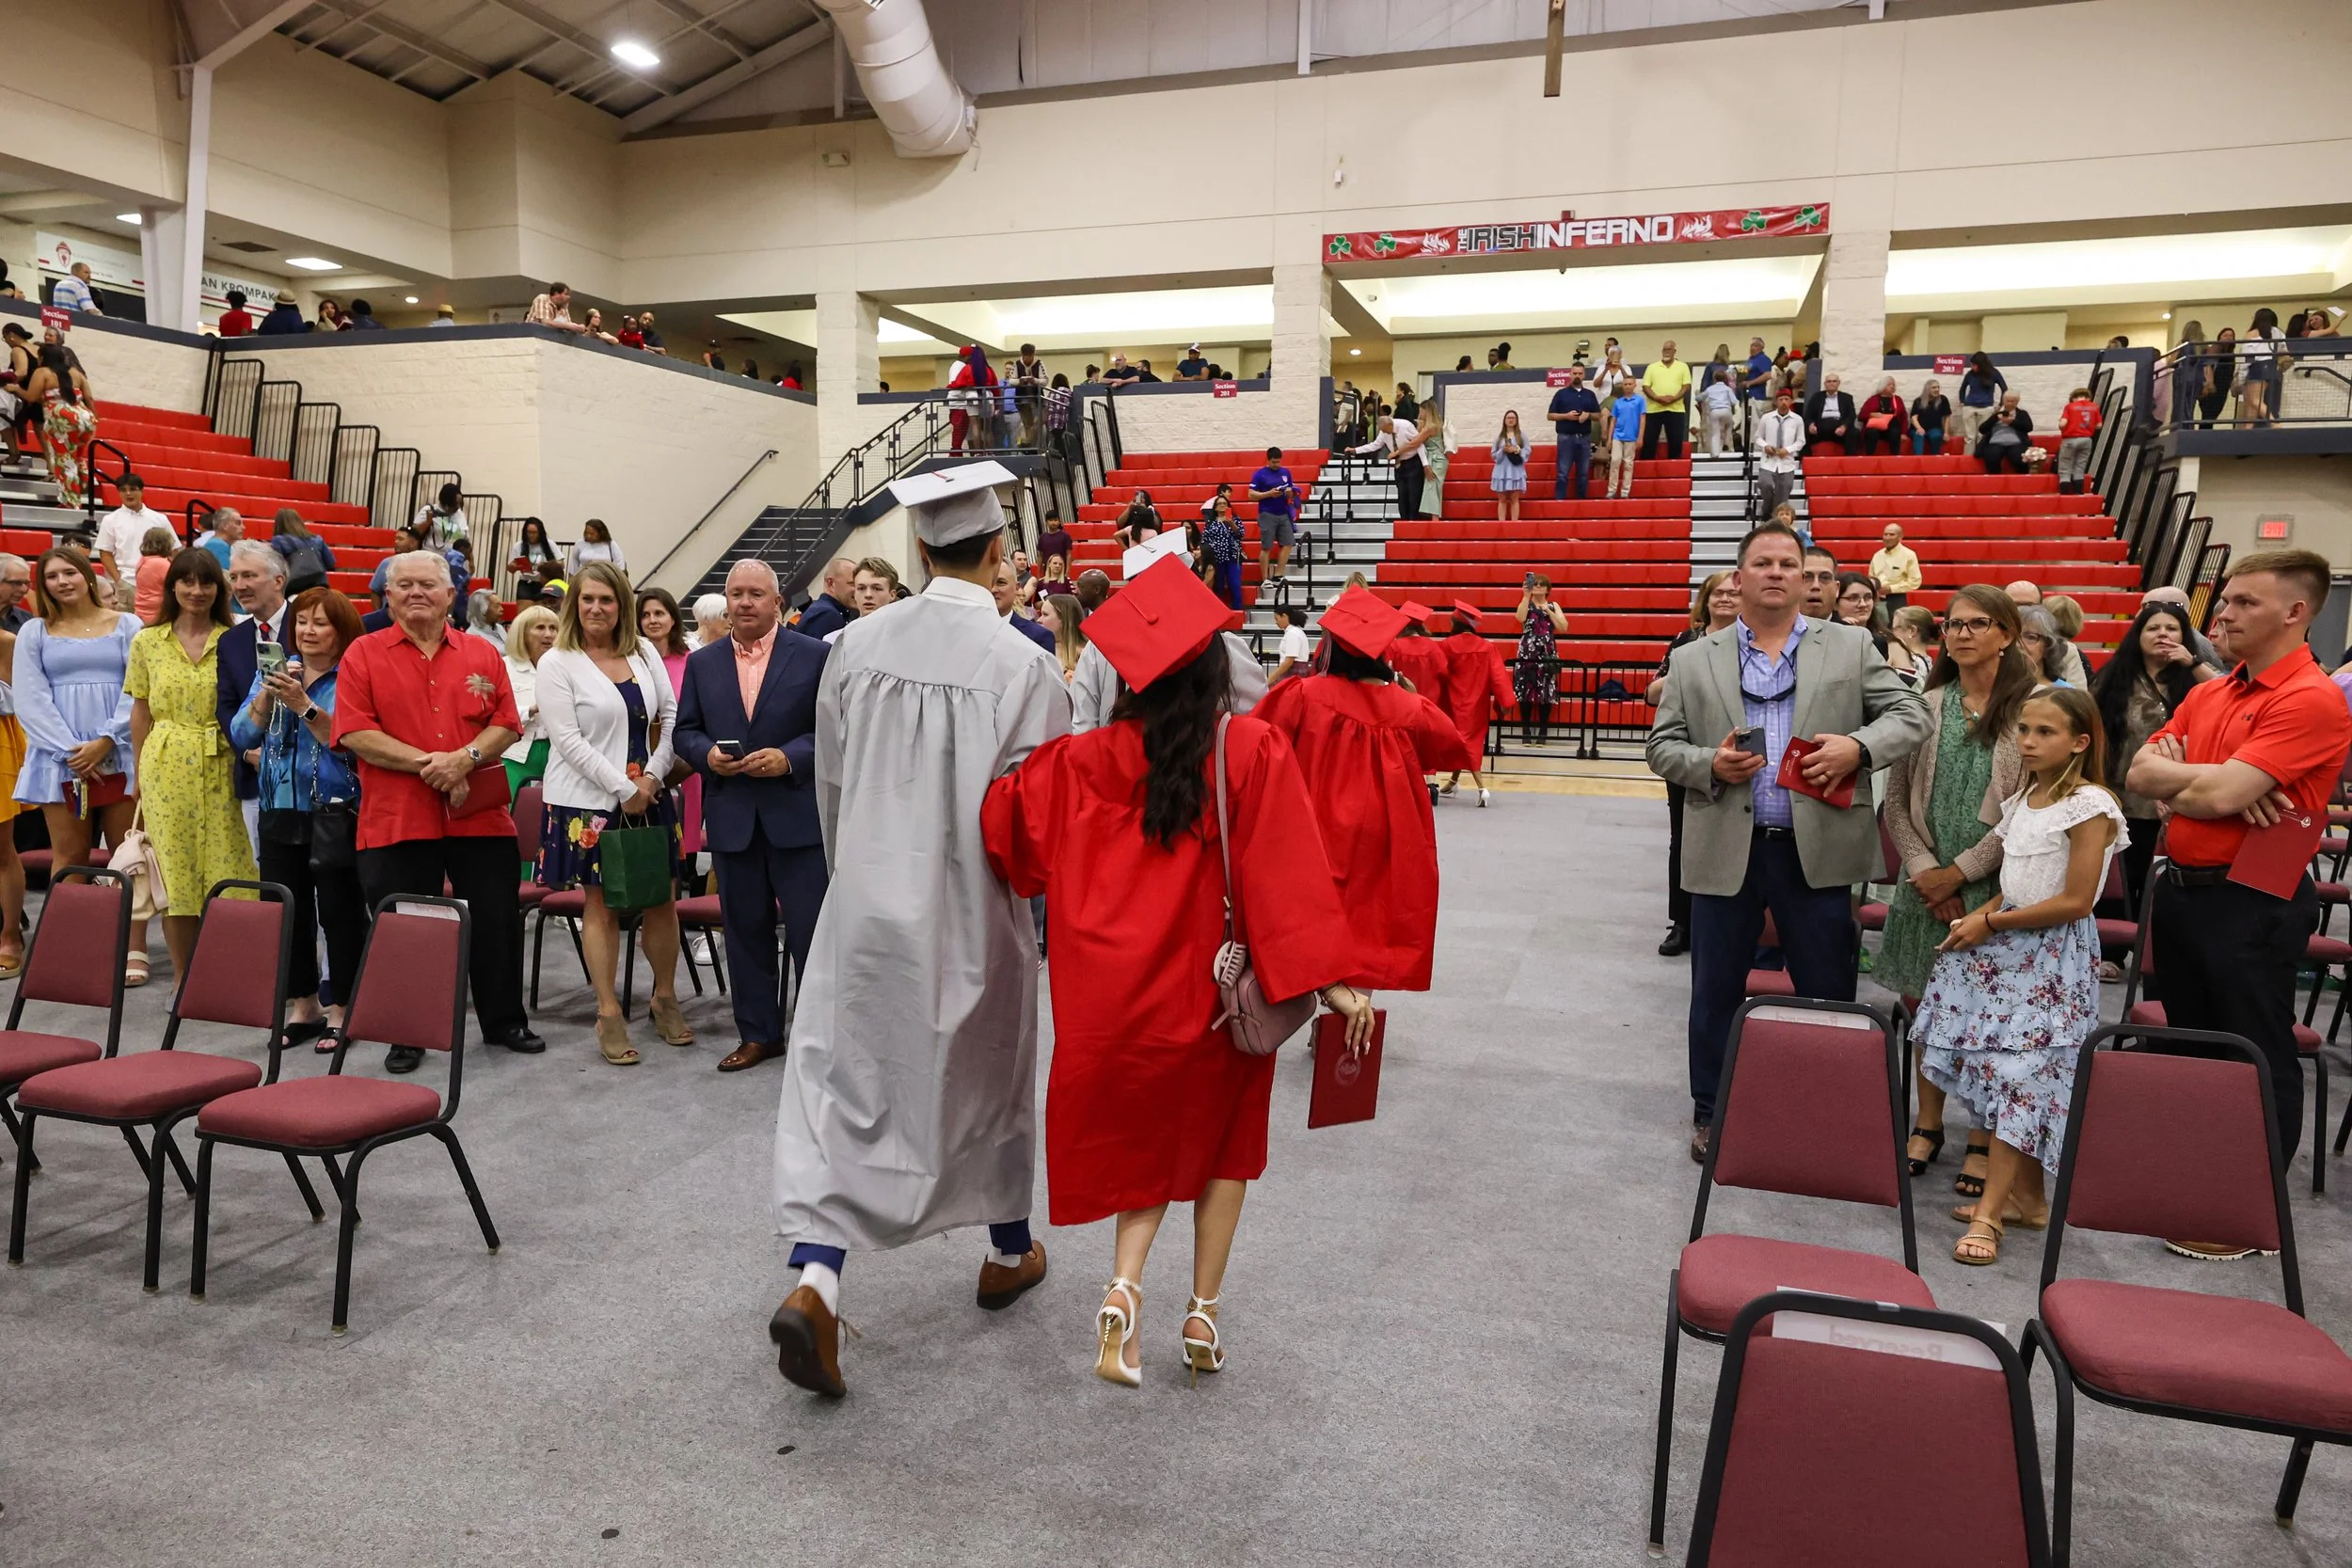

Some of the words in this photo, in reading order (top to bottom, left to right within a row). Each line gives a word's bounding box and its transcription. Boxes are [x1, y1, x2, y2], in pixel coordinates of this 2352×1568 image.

[1457, 228, 1469, 252] THE
[1468, 224, 1536, 252] IRISH
[1536, 215, 1675, 249] INFERNO
[42, 309, 70, 321] Section
[1936, 356, 1963, 365] Section
